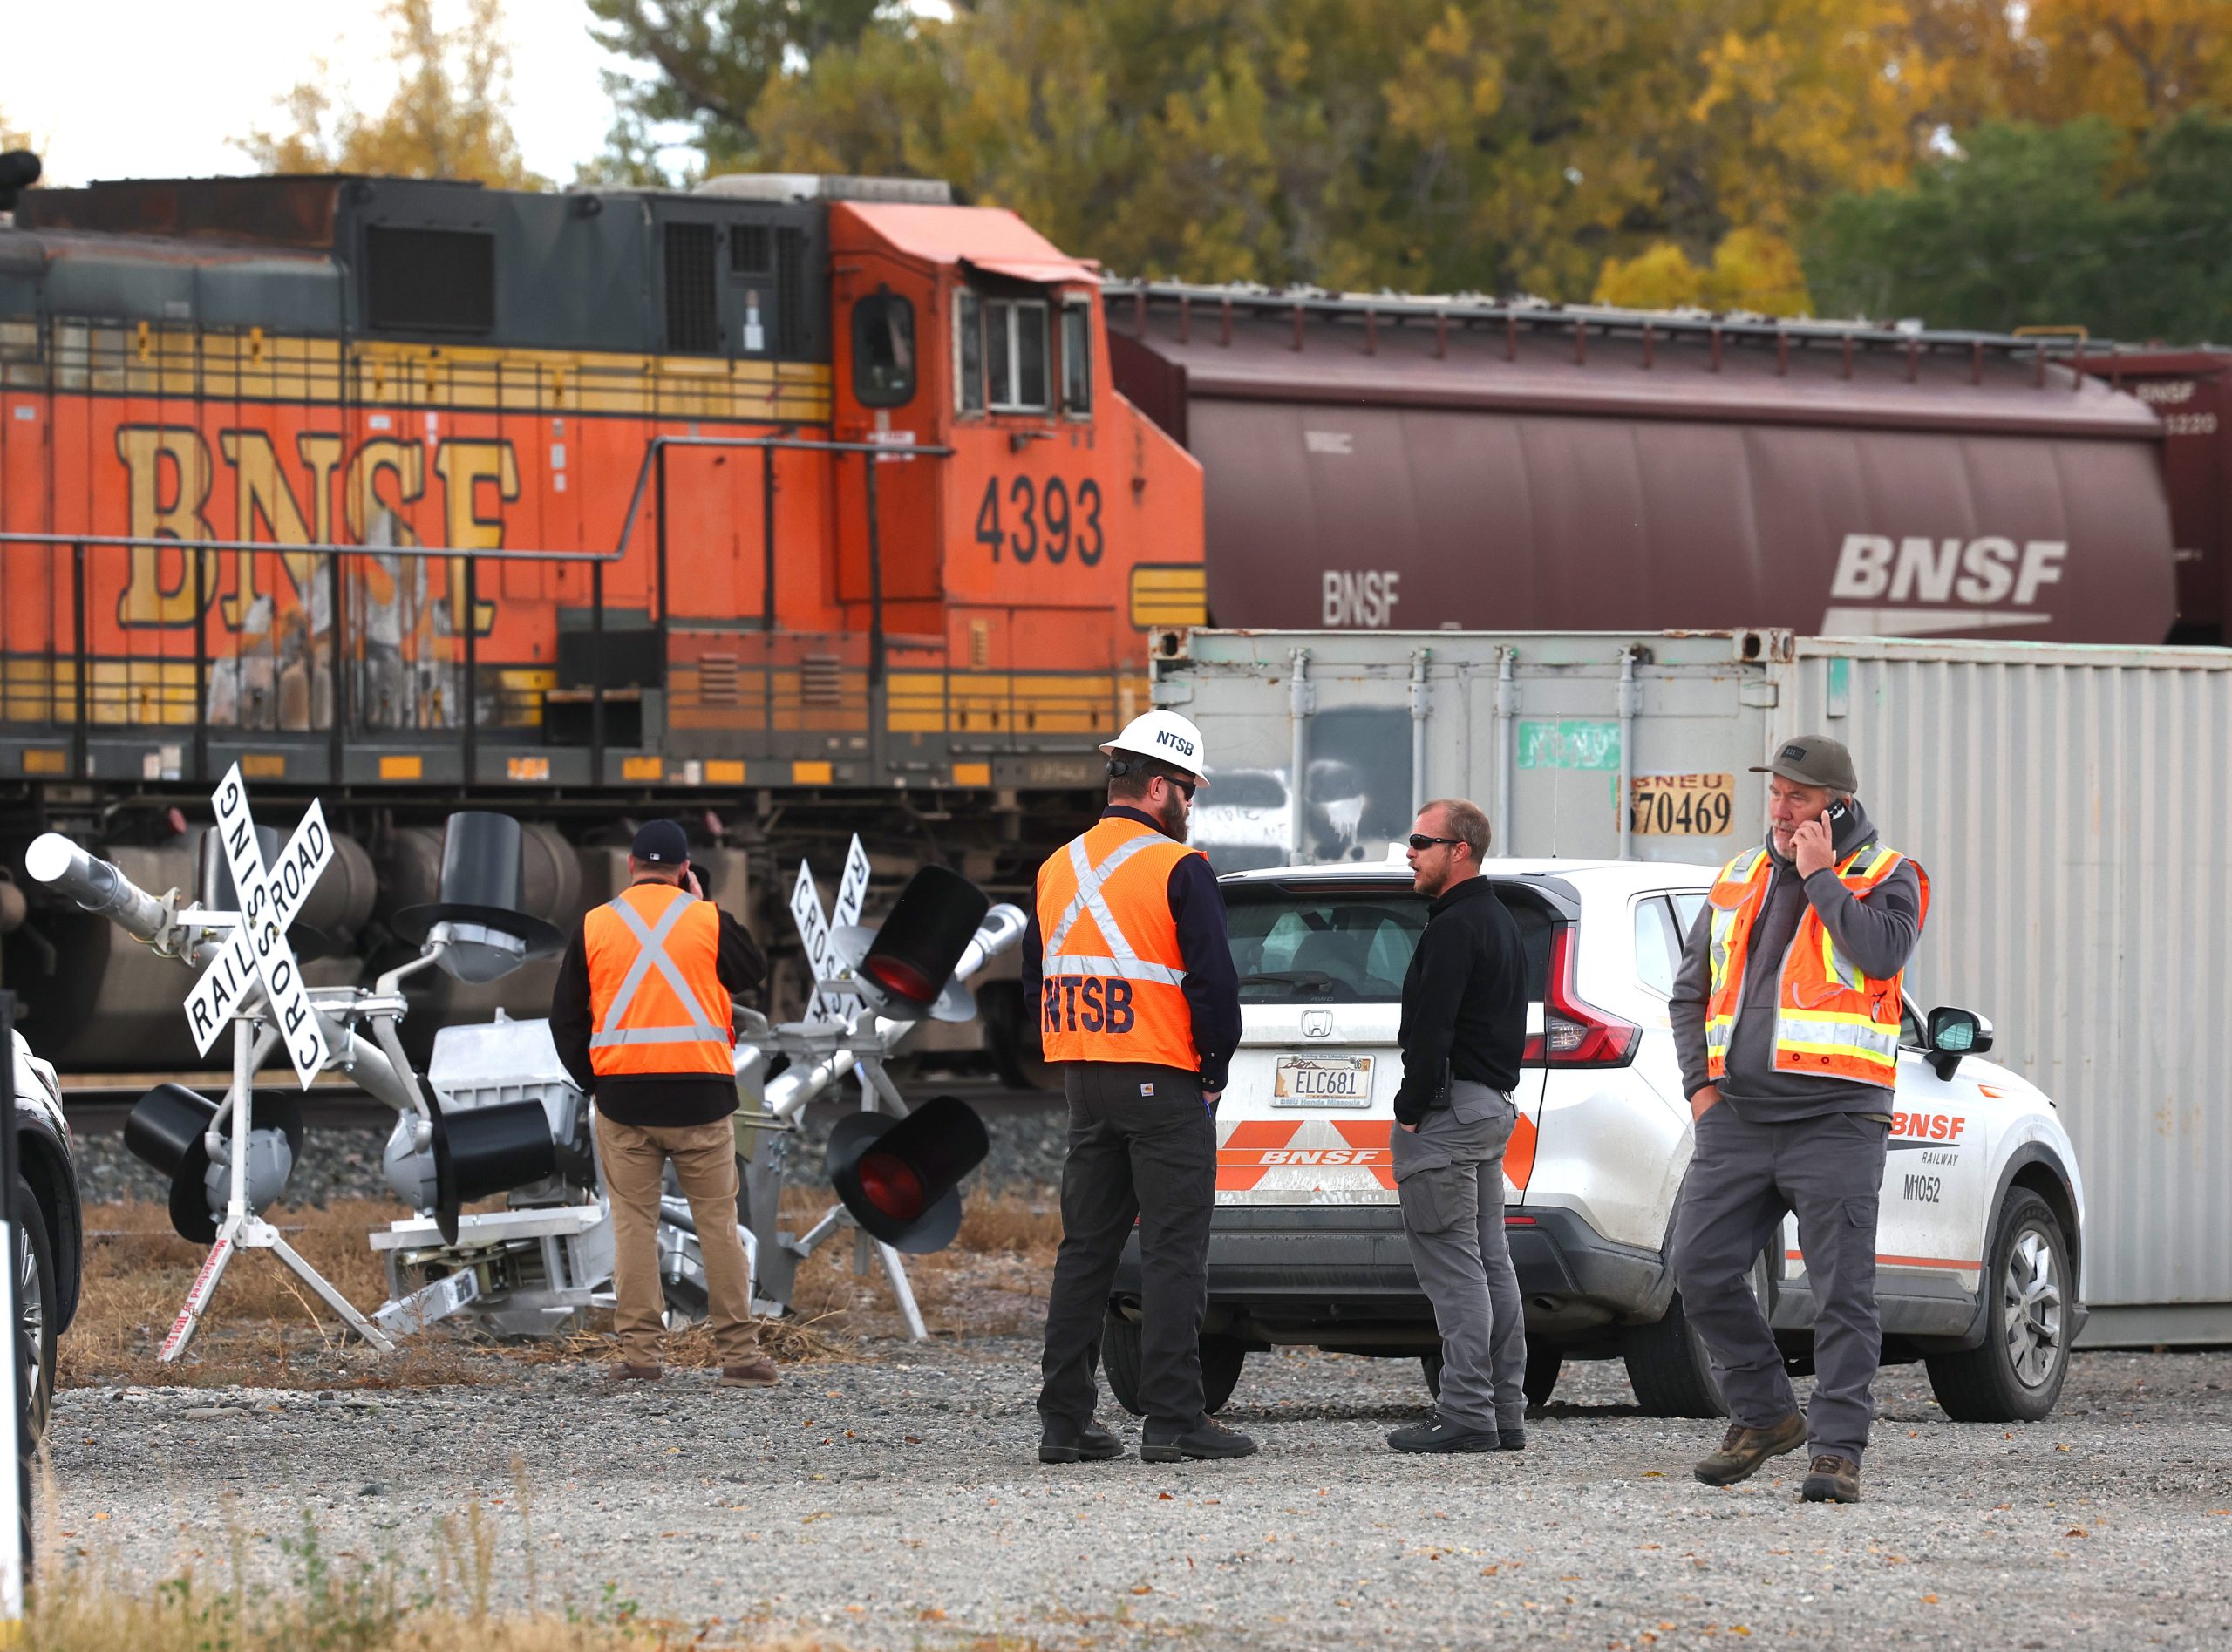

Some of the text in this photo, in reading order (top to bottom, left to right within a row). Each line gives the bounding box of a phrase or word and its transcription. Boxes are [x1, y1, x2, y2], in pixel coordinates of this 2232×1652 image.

[116, 423, 520, 637] BNSF
[976, 475, 1103, 567] 4393
[1831, 534, 2068, 605] BNSF
[1322, 569, 1400, 627] BNSF
[1156, 730, 1194, 757] NTSB
[1630, 792, 1732, 834] 70469
[221, 782, 319, 1071] CROSSING
[1044, 976, 1135, 1034] NTSB
[1296, 1071, 1357, 1095] ELC681
[1889, 1112, 1965, 1139] BNSF
[1258, 1150, 1380, 1165] BNSF
[1921, 1152, 1958, 1166] RAILWAY
[1903, 1174, 1941, 1203] M1052
[191, 1239, 228, 1298] Manufactured
